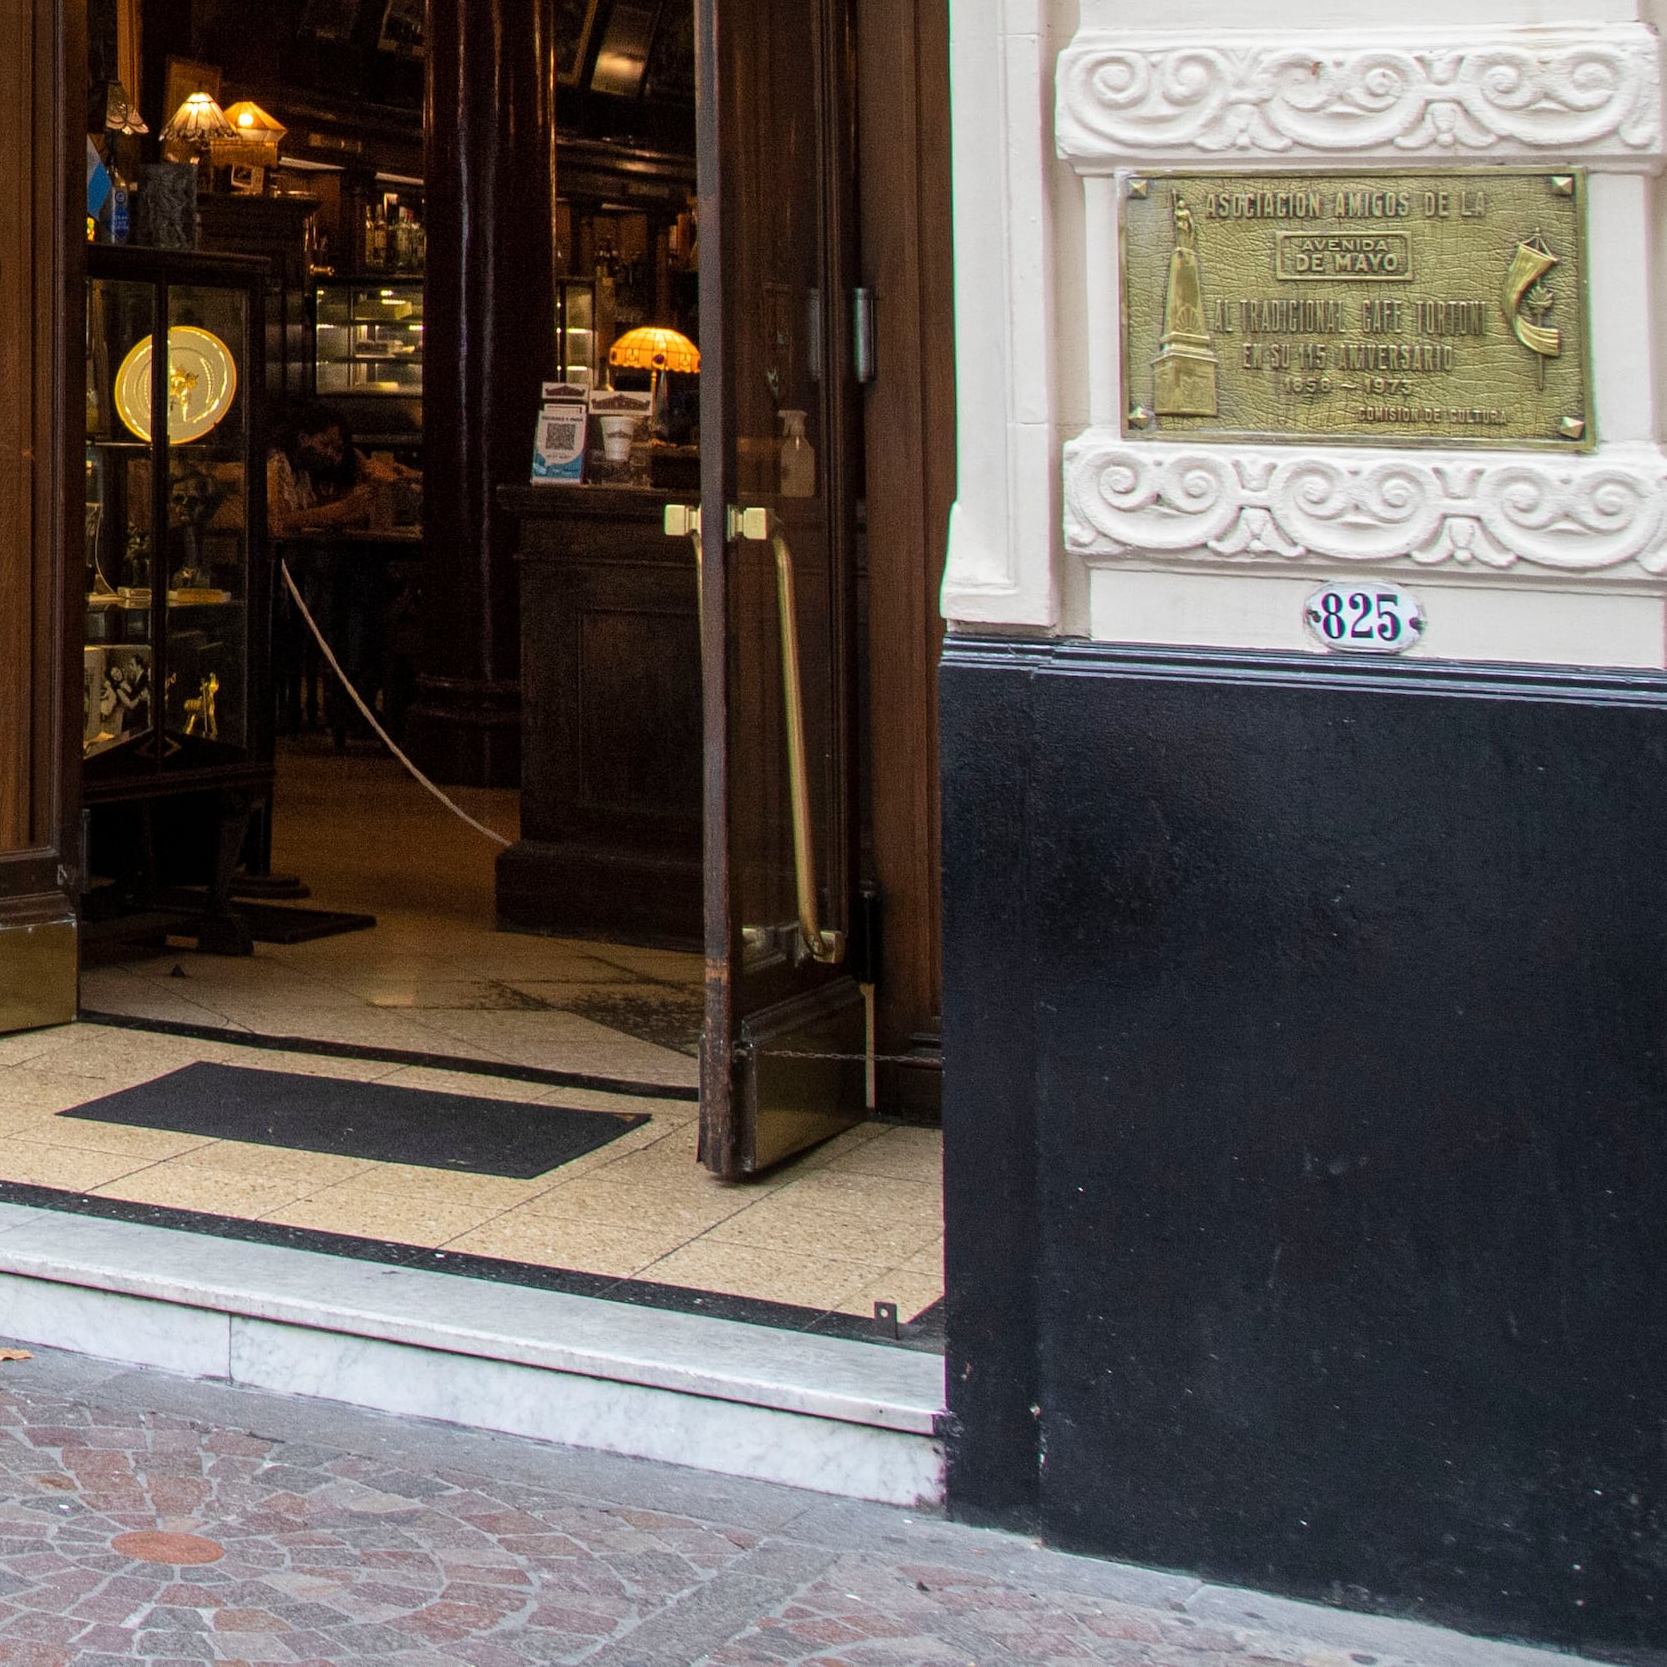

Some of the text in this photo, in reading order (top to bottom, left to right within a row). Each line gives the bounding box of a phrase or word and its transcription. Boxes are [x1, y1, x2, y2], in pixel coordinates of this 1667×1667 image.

[1206, 192, 1487, 218] ASOCIACION AMIGOS DE LA
[1300, 240, 1389, 251] AVENIDA
[1297, 254, 1398, 272] DE MAYO
[1217, 298, 1487, 334] AL TRADICIONAL CAFE TORTONI
[1243, 344, 1453, 372] EN SU 115 ANIVERSARIO
[1283, 378, 1413, 395] 1858 1973
[1358, 406, 1507, 424] COMISION CULTURA
[1321, 593, 1401, 641] 825
